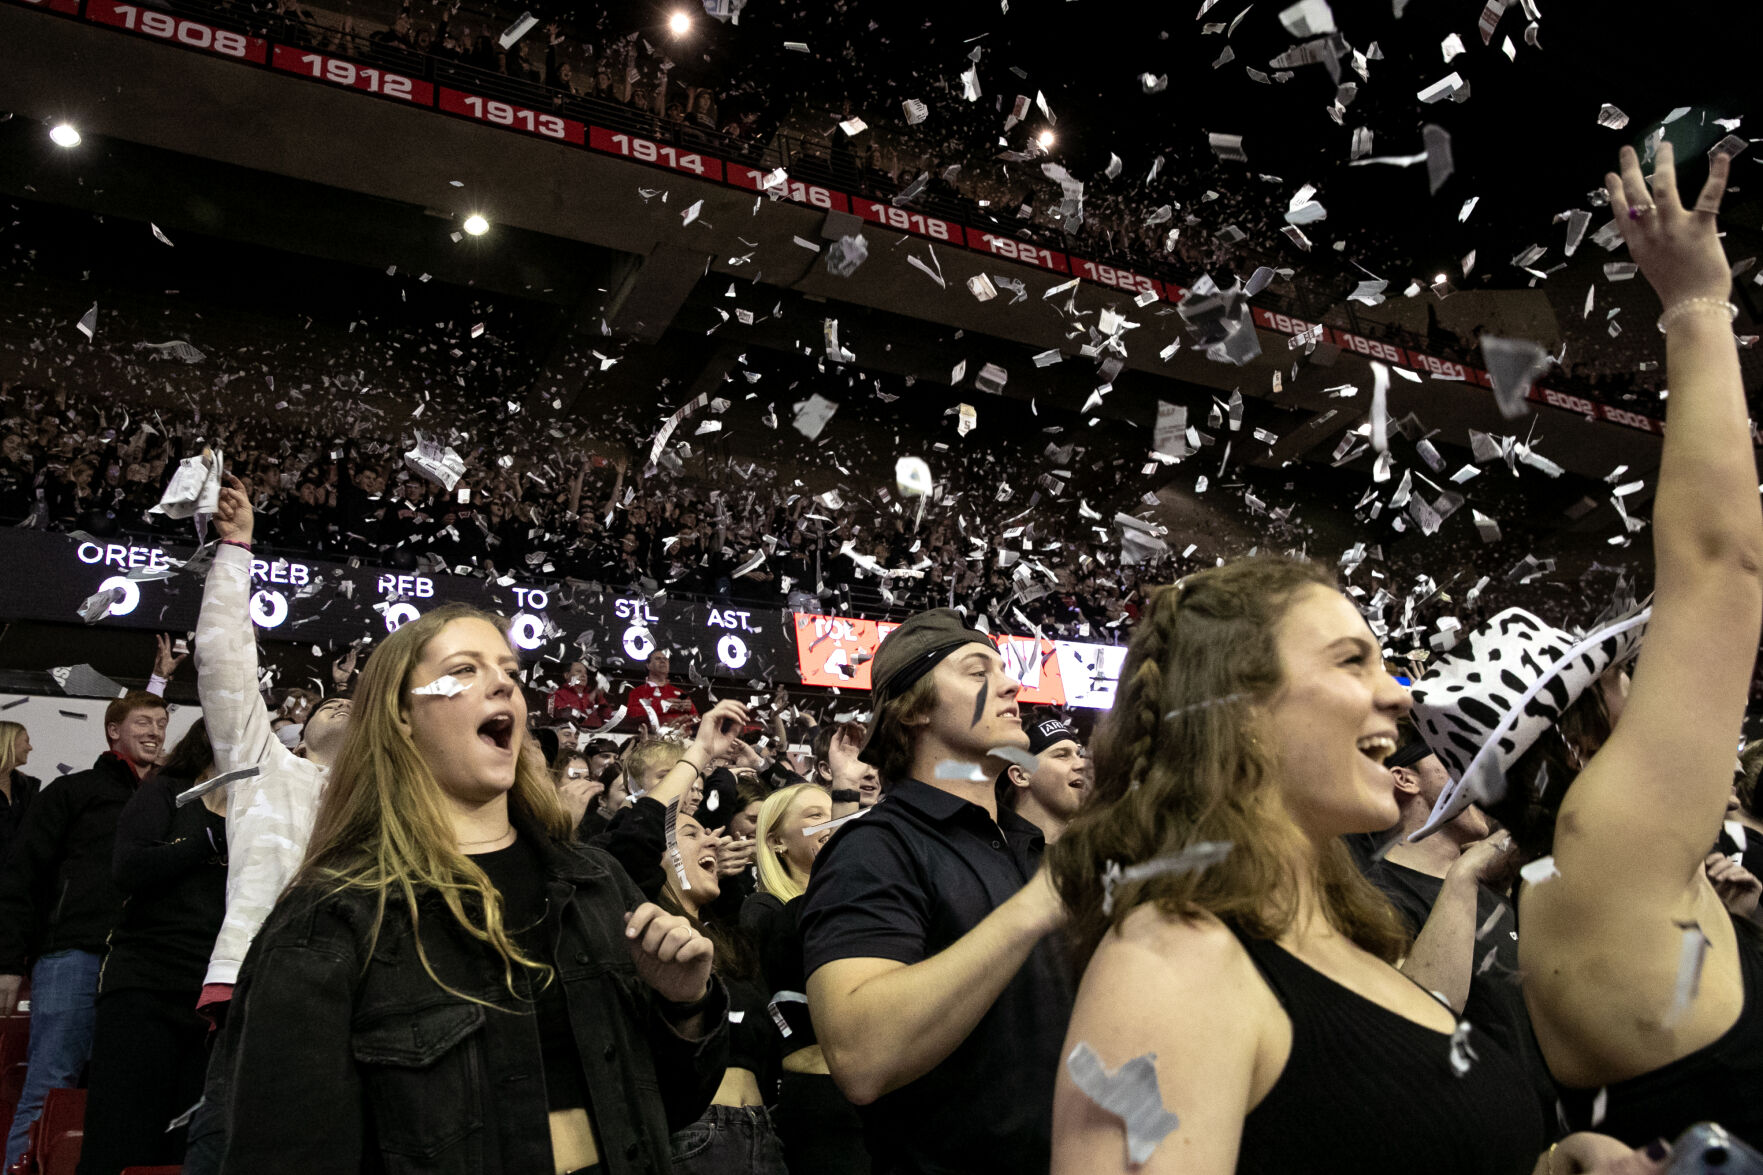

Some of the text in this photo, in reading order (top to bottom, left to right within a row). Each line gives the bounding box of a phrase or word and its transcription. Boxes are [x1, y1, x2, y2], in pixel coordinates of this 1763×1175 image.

[113, 5, 247, 58] 1908
[302, 54, 412, 100] 1912
[464, 96, 566, 138] 1913
[611, 134, 704, 174] 1914
[870, 203, 949, 240] 1918
[982, 234, 1053, 269] 1921
[1084, 262, 1152, 292] 1923
[1343, 334, 1399, 363] 1935
[1418, 354, 1466, 377] 1941
[1545, 389, 1595, 416] 2002
[1604, 406, 1651, 431] 2003
[378, 574, 434, 598] REB
[512, 588, 548, 609] TO
[250, 590, 289, 628] 0
[615, 599, 659, 622] STL
[707, 609, 751, 630] AST
[511, 614, 546, 650] 0
[623, 626, 657, 660] 0
[717, 635, 748, 669] 0
